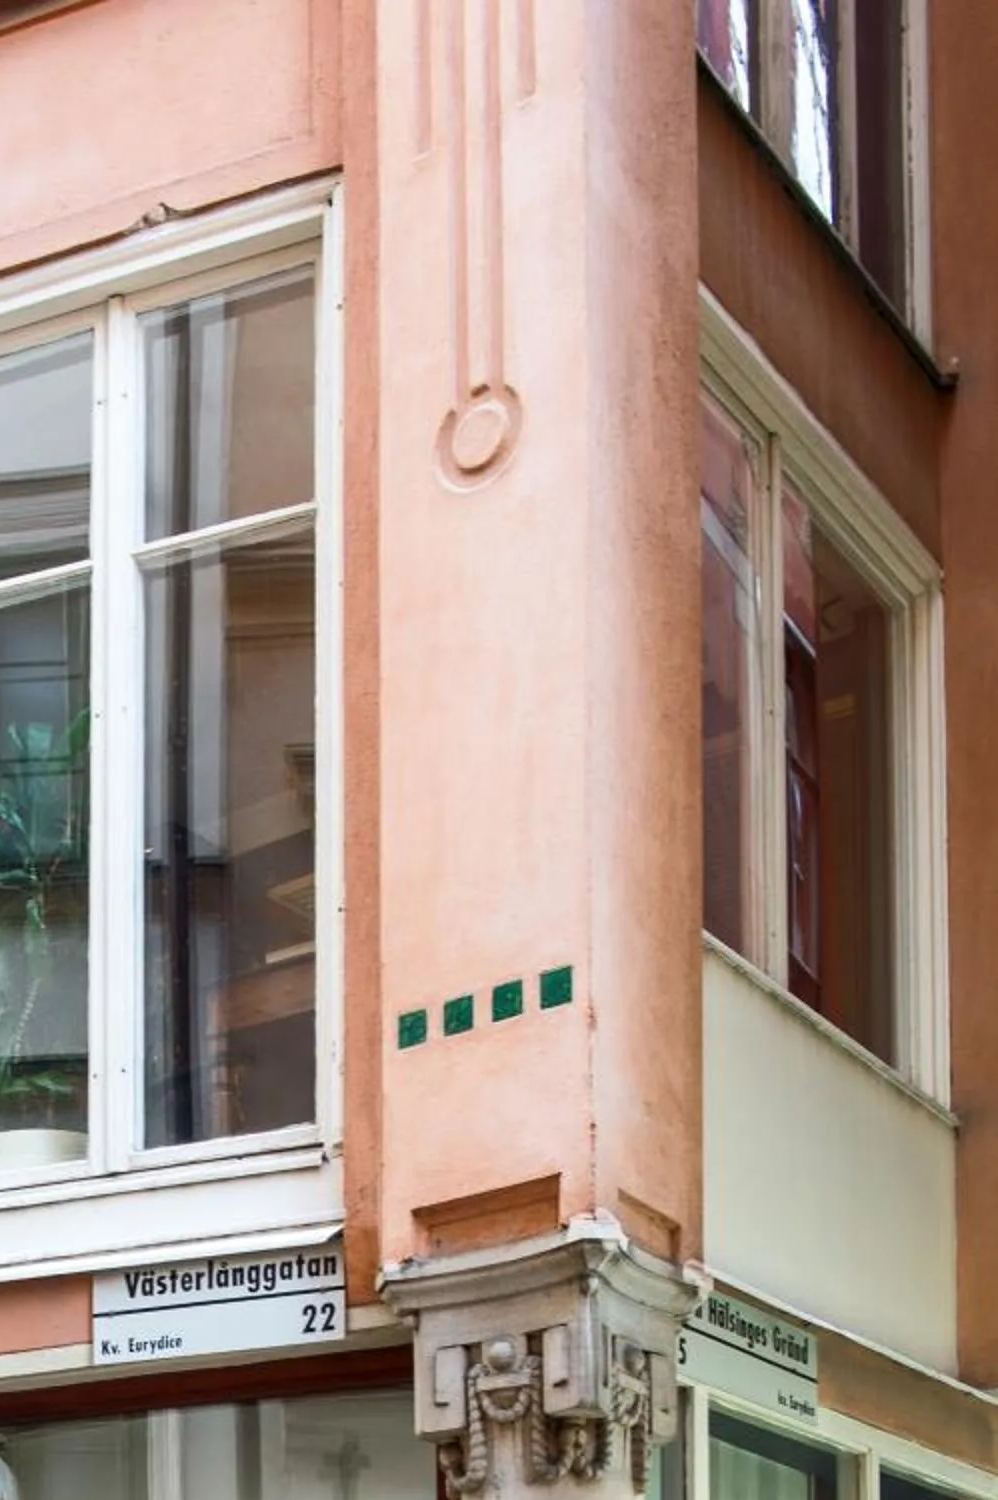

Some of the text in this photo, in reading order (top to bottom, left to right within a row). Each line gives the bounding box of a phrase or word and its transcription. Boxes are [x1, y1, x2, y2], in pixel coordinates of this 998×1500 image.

[123, 1254, 337, 1299] Västerlånggatan
[302, 1302, 336, 1334] 22
[128, 1335, 183, 1355] Eurydice
